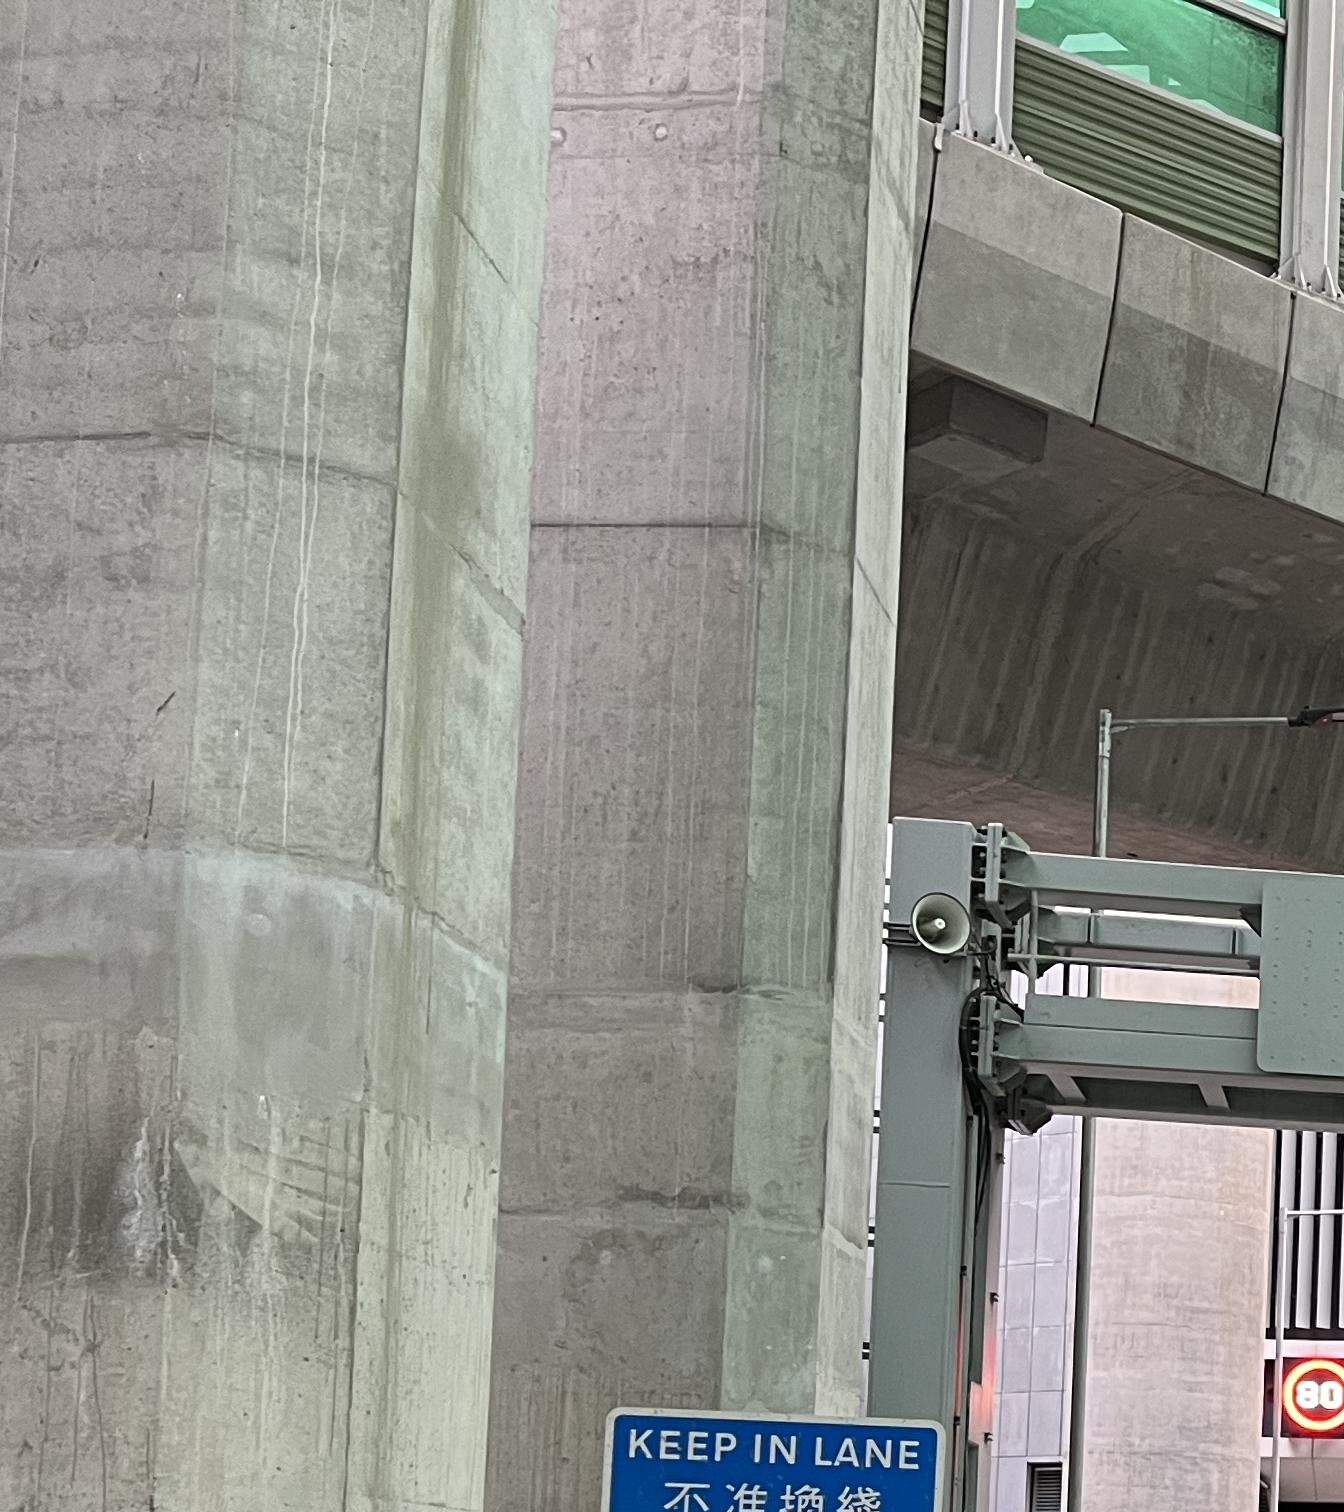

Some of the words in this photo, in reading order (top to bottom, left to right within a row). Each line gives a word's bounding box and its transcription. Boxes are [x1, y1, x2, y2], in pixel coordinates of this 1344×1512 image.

[1296, 1380, 1342, 1408] 80
[628, 1428, 737, 1462] KEEP
[753, 1433, 796, 1465] IN
[814, 1436, 920, 1470] LANE
